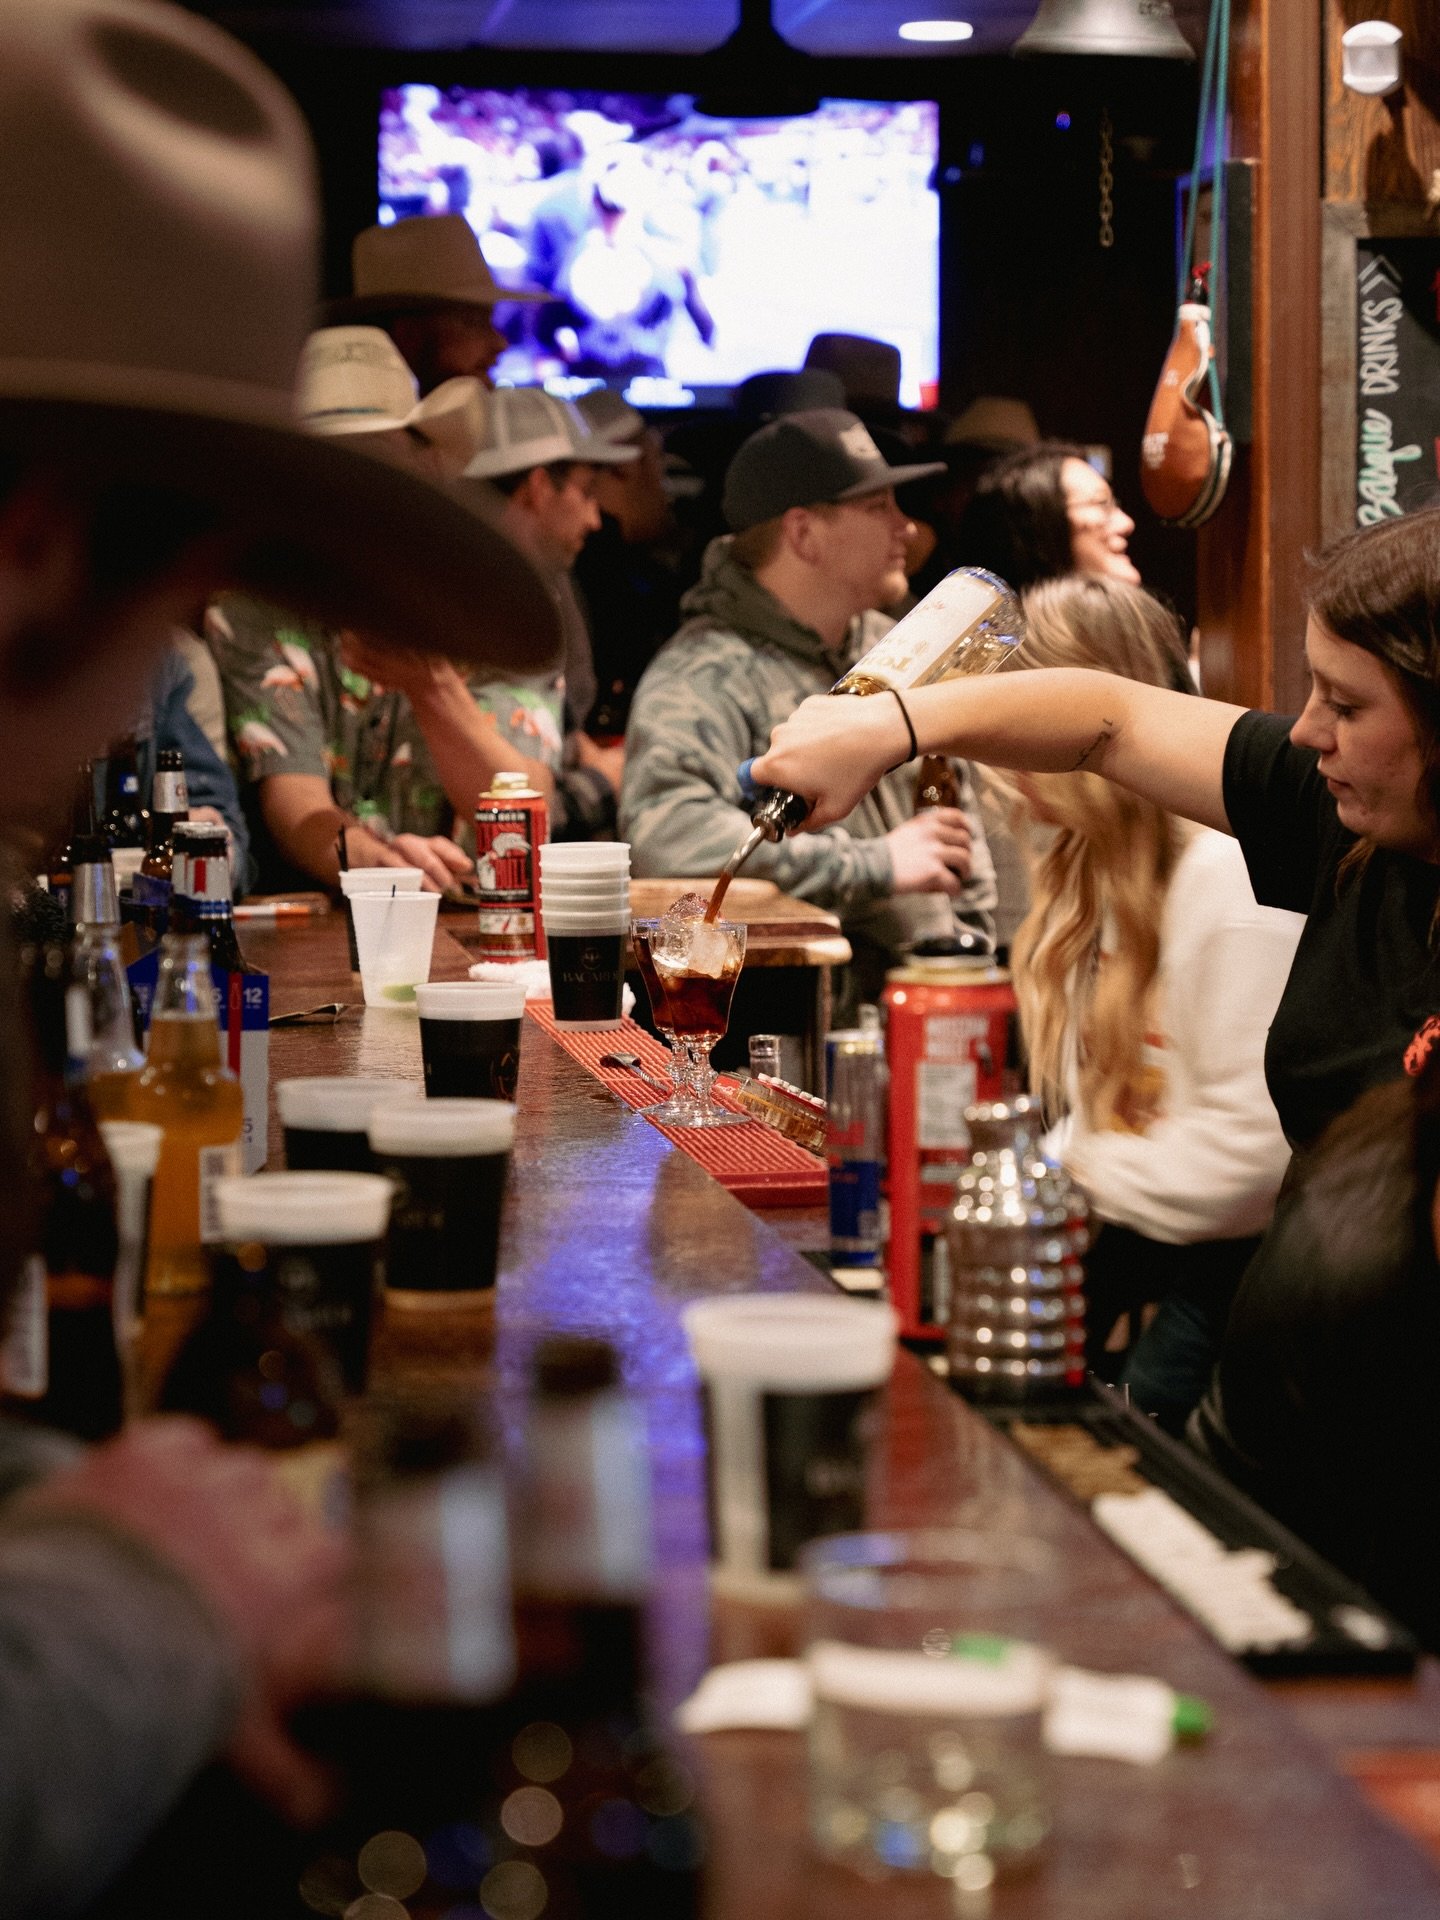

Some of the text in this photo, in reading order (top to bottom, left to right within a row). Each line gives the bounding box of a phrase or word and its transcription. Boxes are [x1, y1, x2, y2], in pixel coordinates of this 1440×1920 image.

[1357, 296, 1423, 527] Basque DRINKS
[243, 987, 263, 1004] 12
